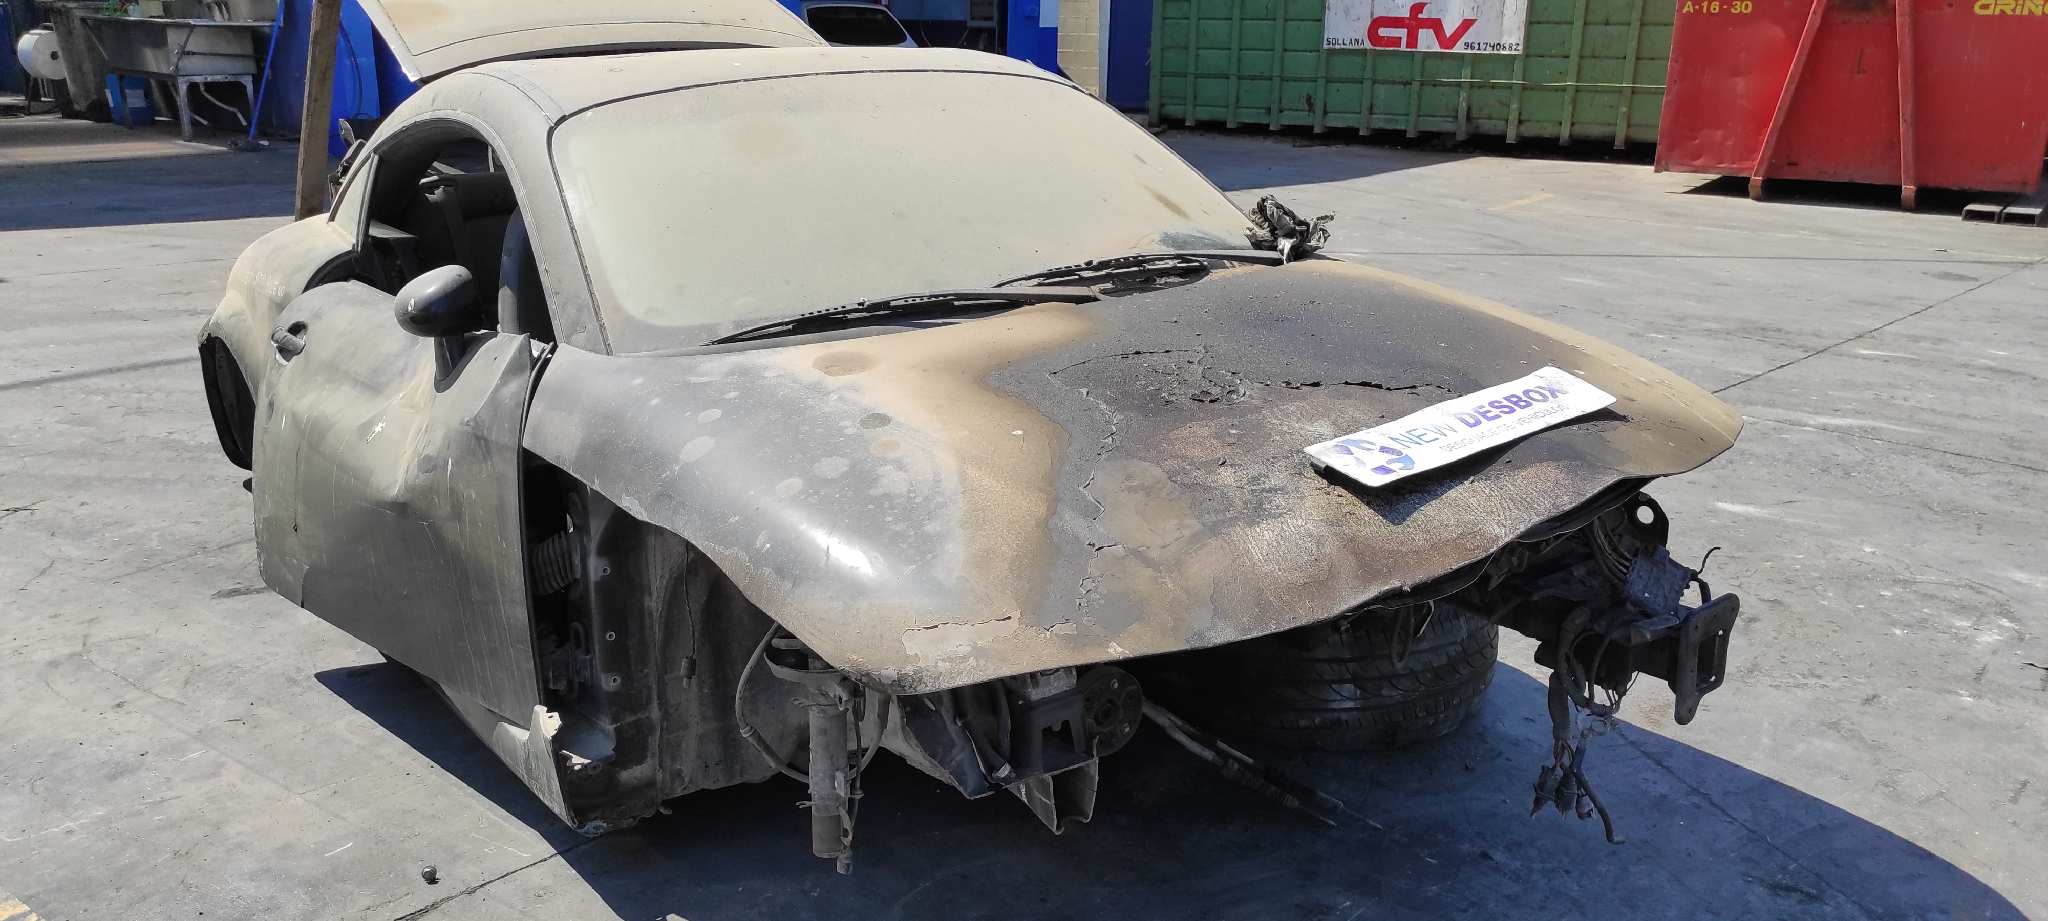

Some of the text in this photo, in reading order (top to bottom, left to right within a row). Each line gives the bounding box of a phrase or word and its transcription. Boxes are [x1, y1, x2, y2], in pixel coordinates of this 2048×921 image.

[1325, 37, 1365, 47] SOLLANA
[1390, 383, 1570, 448] NEW DESBOX
